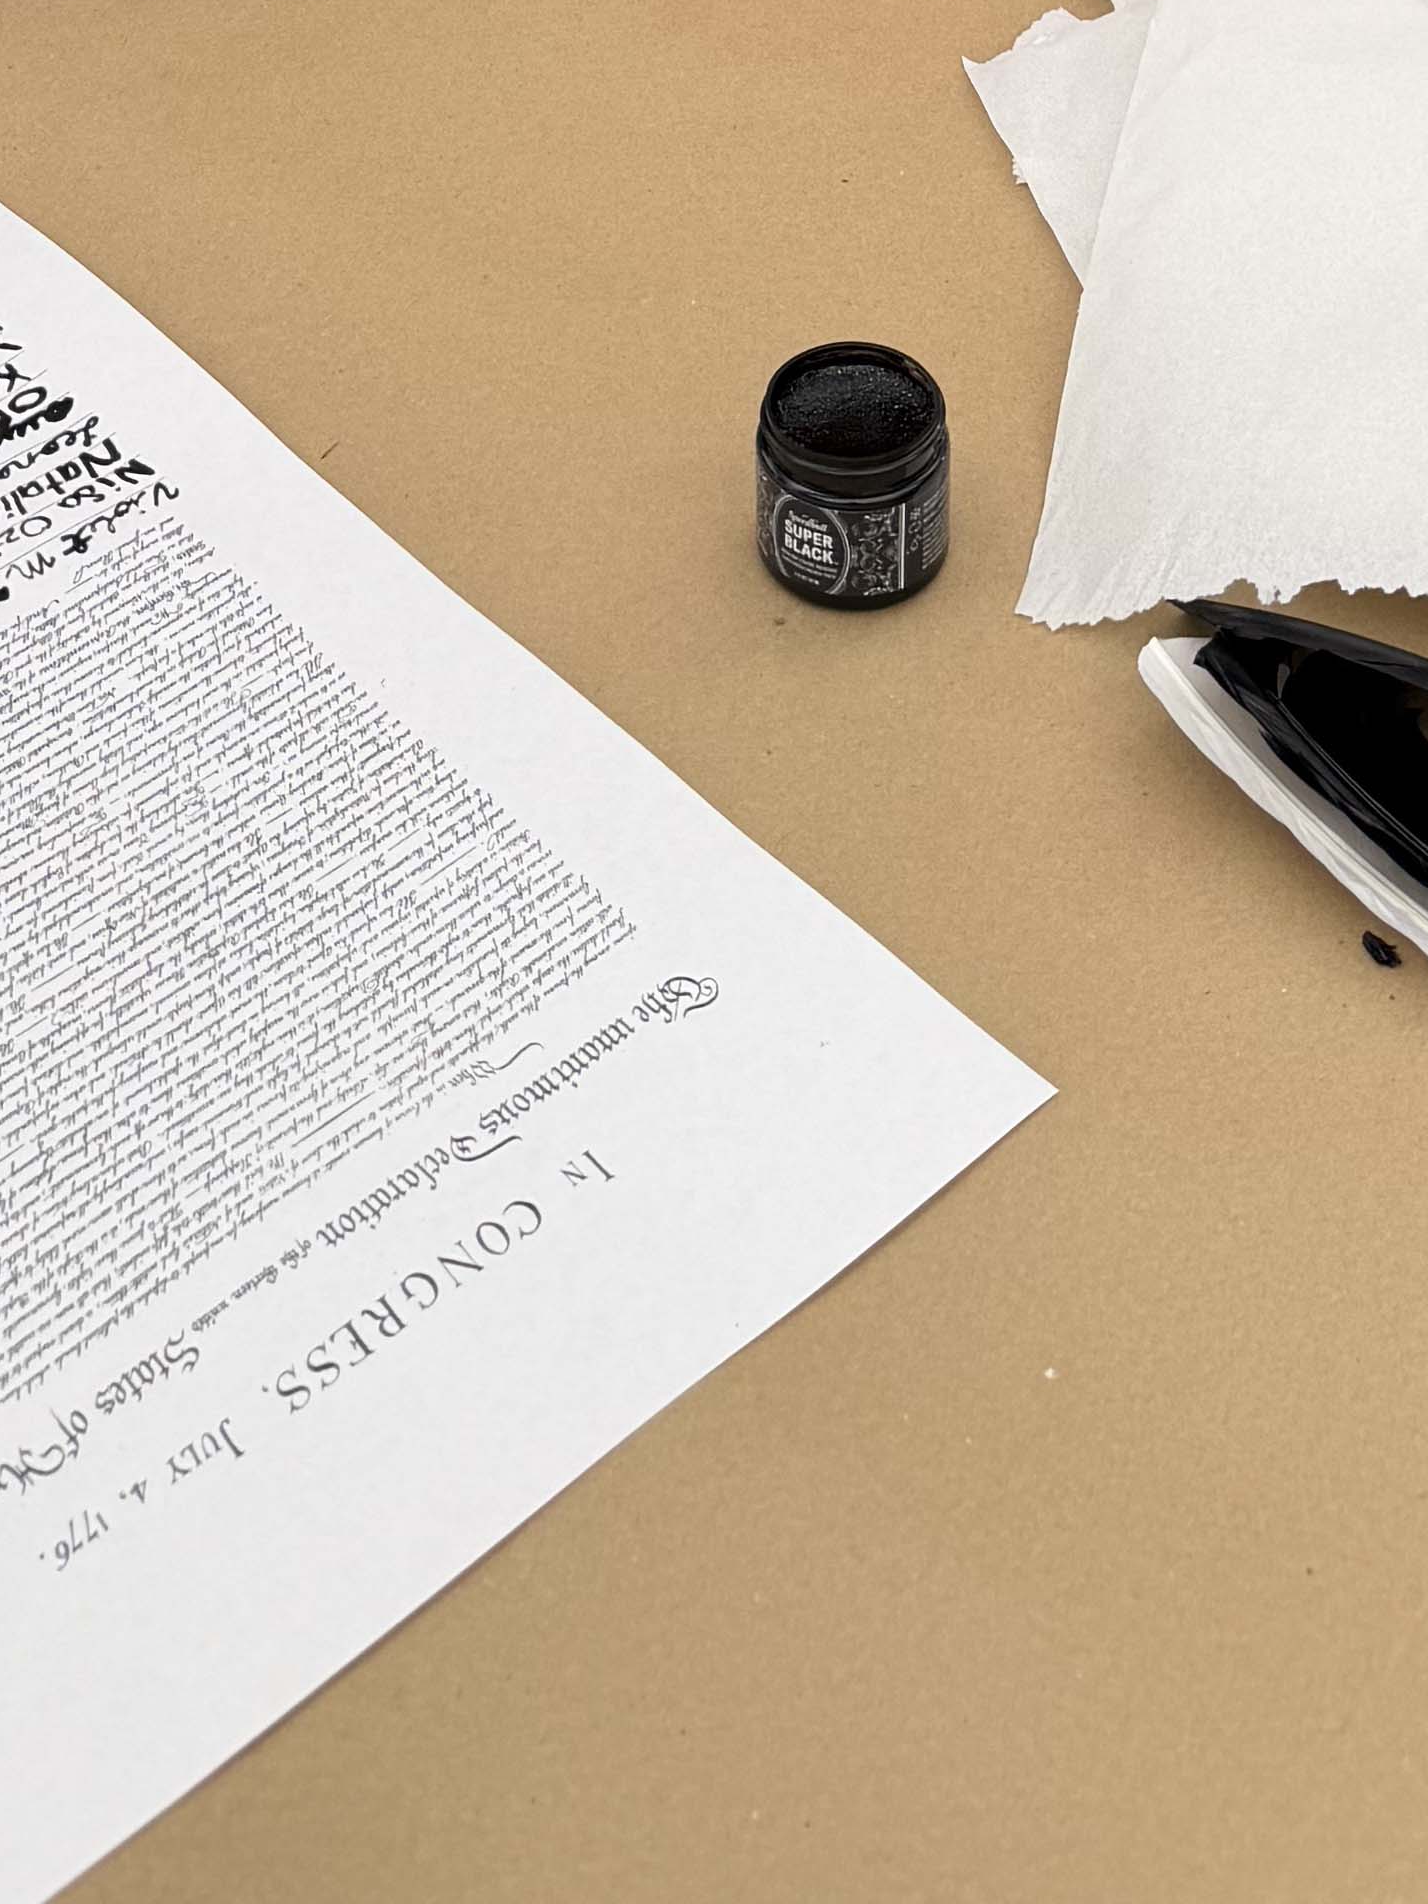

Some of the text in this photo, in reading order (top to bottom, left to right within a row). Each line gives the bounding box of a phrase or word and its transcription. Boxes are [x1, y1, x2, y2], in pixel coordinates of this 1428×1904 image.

[785, 519, 833, 549] SUPER
[785, 533, 833, 564] BLACK
[631, 975, 720, 1025] The
[499, 1017, 636, 1120] unanimous
[315, 1108, 523, 1248] Declaration
[559, 1149, 616, 1187] IN
[94, 1328, 200, 1415] States
[51, 1409, 89, 1459] of
[166, 1417, 245, 1485] JULY
